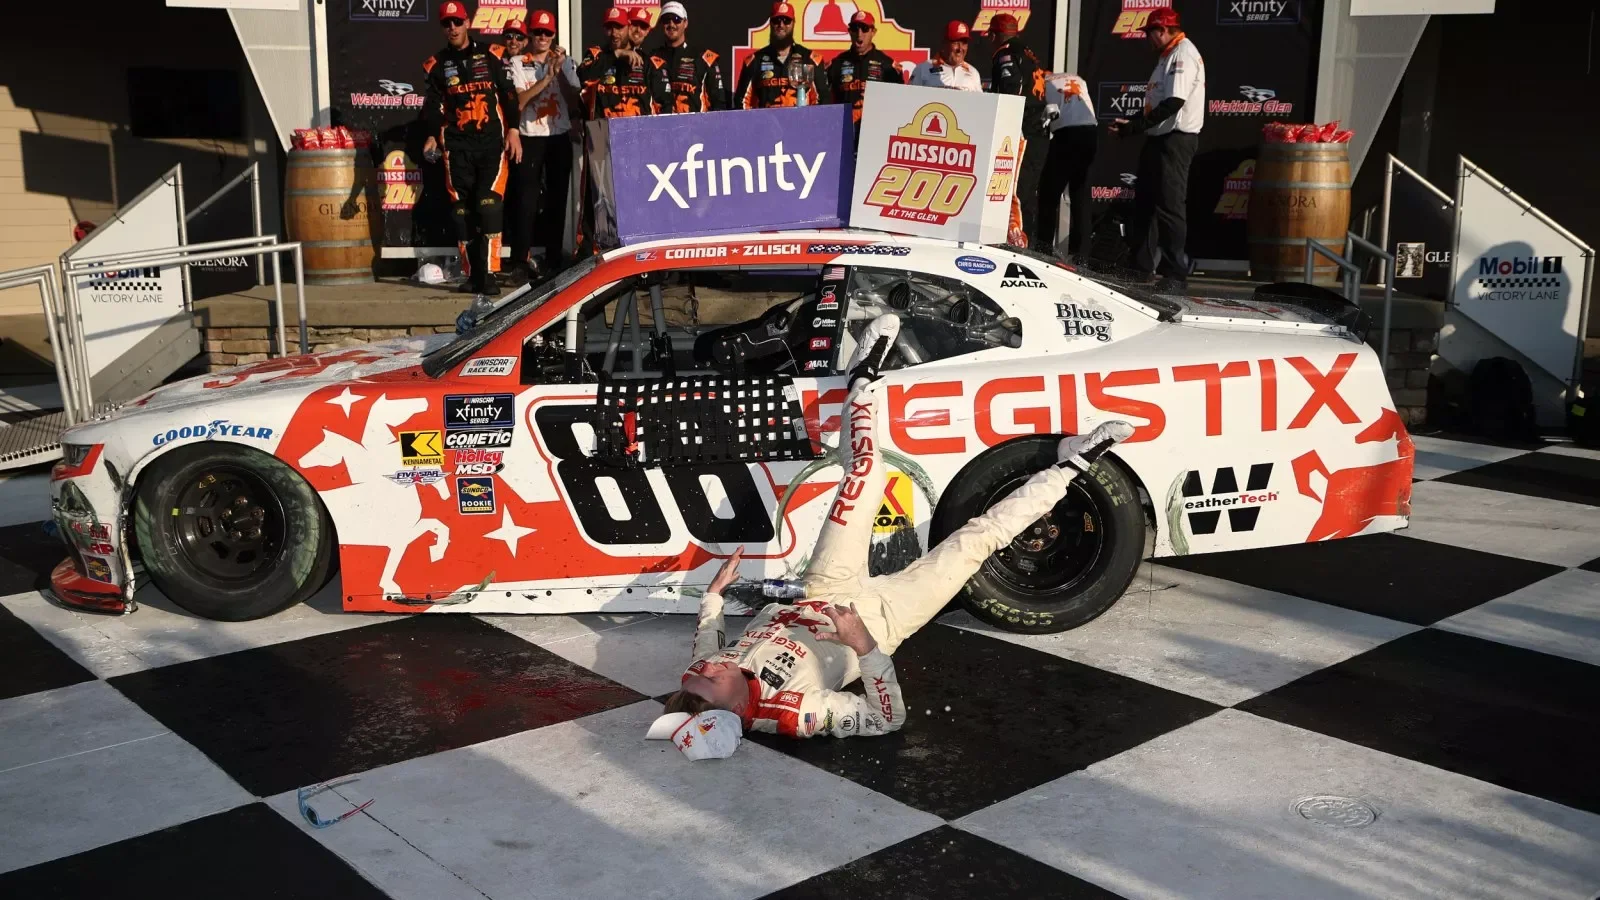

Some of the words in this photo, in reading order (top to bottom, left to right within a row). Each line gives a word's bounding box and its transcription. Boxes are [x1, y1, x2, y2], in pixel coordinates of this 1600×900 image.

[378, 10, 400, 18] SERIES
[350, 92, 402, 107] Watkins
[1208, 100, 1263, 113] Watkins
[646, 140, 827, 209] xfinity
[866, 165, 976, 217] 200
[888, 208, 900, 216] AT
[900, 210, 918, 219] THE
[917, 212, 939, 222] GLEN
[665, 247, 727, 260] CONNOR
[742, 244, 801, 257] ZILISCH
[1479, 257, 1539, 275] Mobil
[1000, 280, 1048, 289] AXALTA
[91, 293, 134, 303] VICTORY
[136, 293, 164, 303] LANE
[1477, 291, 1527, 301] VICTORY
[1529, 290, 1559, 300] LANE
[1054, 302, 1114, 323] Blues
[1063, 319, 1113, 342] Hog
[812, 339, 827, 348] SEM
[480, 358, 509, 366] NASCAR
[455, 404, 503, 421] xfinity
[445, 431, 512, 446] COMETIC
[455, 448, 503, 465] Holley
[828, 400, 874, 528] REGISTIX
[455, 463, 497, 475] MSD
